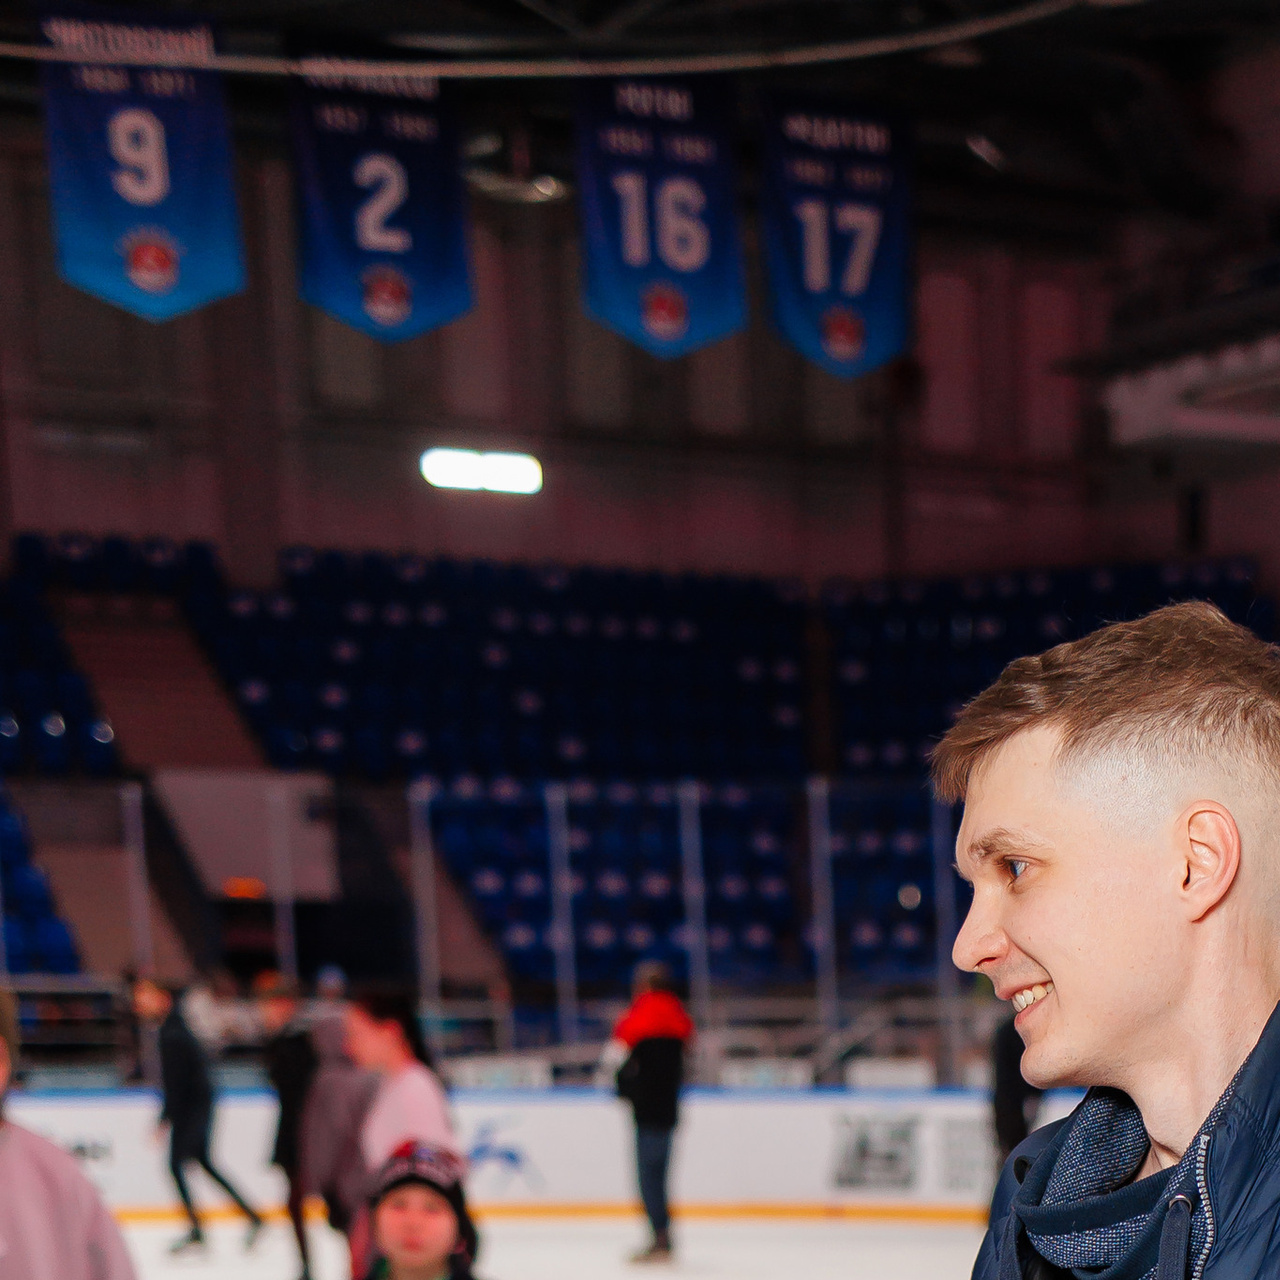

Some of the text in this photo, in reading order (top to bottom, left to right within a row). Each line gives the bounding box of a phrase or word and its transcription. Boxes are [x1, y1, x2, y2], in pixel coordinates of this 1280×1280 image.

[107, 108, 172, 206] 9
[353, 153, 413, 254] 2
[611, 169, 711, 274] 16
[794, 198, 884, 297] 17
